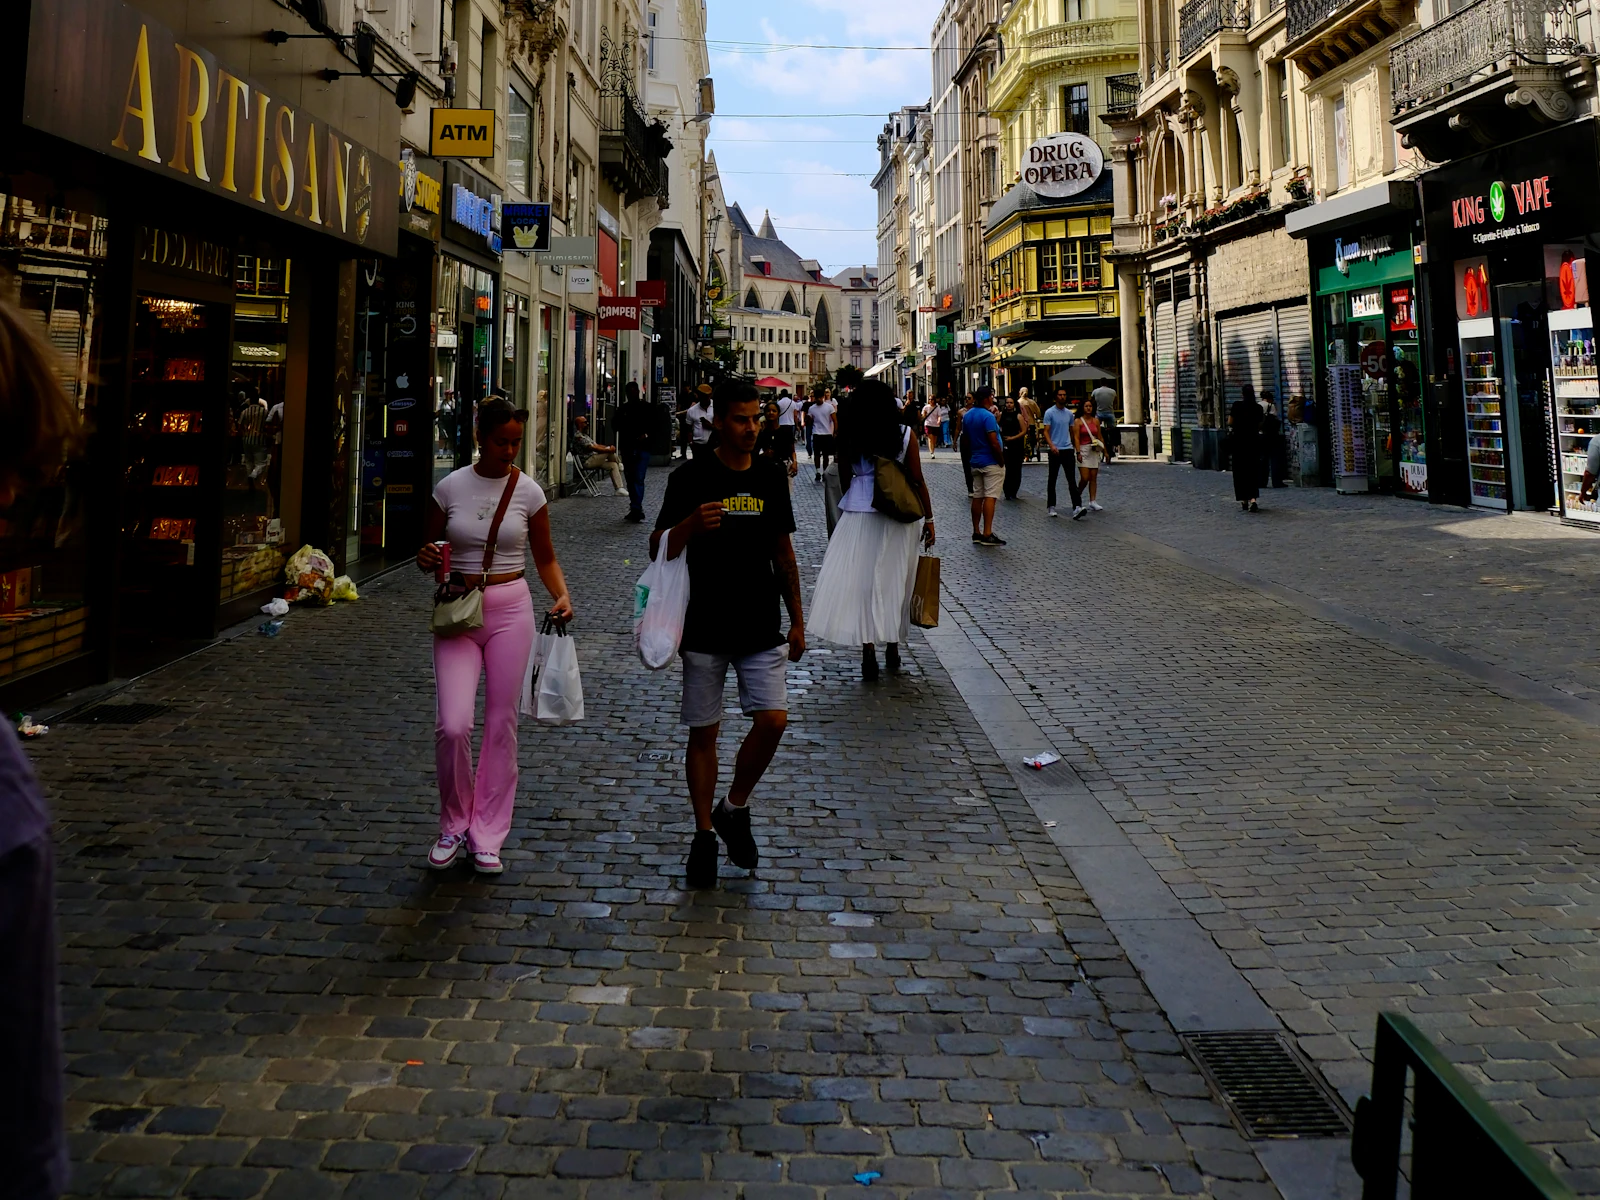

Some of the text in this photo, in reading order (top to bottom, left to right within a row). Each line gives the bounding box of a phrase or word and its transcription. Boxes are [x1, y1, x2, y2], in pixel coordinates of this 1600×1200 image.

[111, 23, 353, 234] ARTISAN
[439, 125, 487, 141] ATM
[1030, 141, 1084, 163] DRUG
[1025, 161, 1094, 185] OPERA
[415, 171, 441, 215] STORE
[1451, 175, 1553, 229] KING VAPE
[503, 205, 549, 217] MARKET
[1521, 222, 1540, 233] Tobacco
[1334, 233, 1393, 274] Queen Bijoux
[395, 301, 416, 309] KING
[599, 305, 637, 320] CAMPER
[722, 496, 764, 512] BEVERLY
